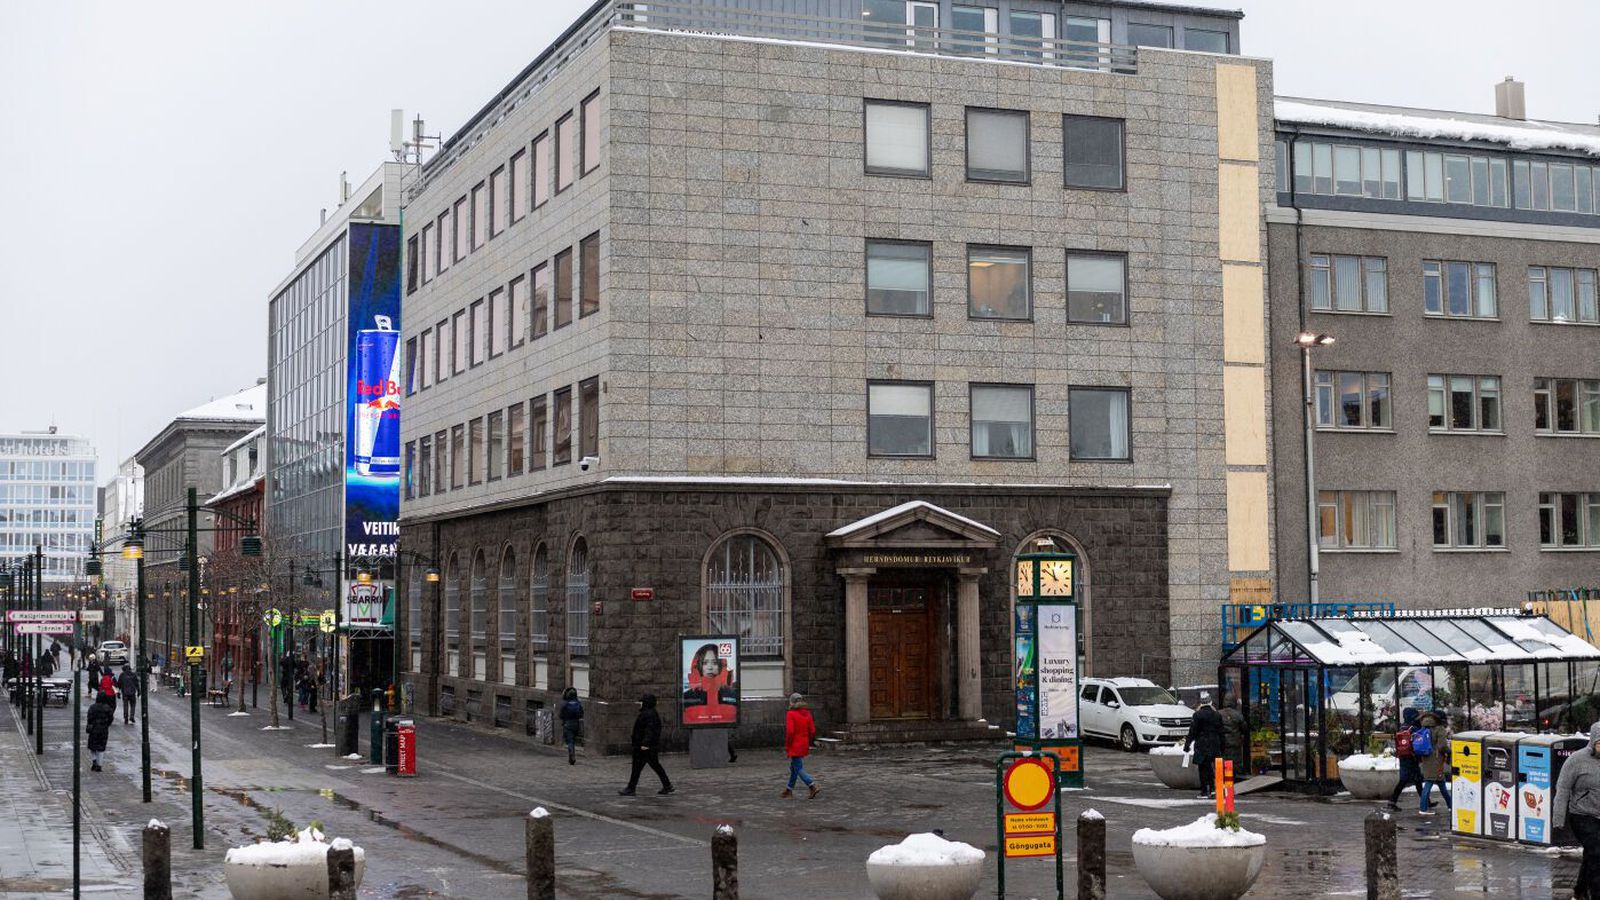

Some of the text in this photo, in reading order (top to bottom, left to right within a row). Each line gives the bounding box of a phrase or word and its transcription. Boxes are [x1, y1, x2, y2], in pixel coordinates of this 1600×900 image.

[357, 379, 383, 395] Red
[347, 595, 382, 605] SBARRO
[1044, 658, 1070, 666] Luxury
[1040, 667, 1074, 675] shopping
[1049, 675, 1073, 684] dining
[1009, 842, 1051, 850] Göngugata
